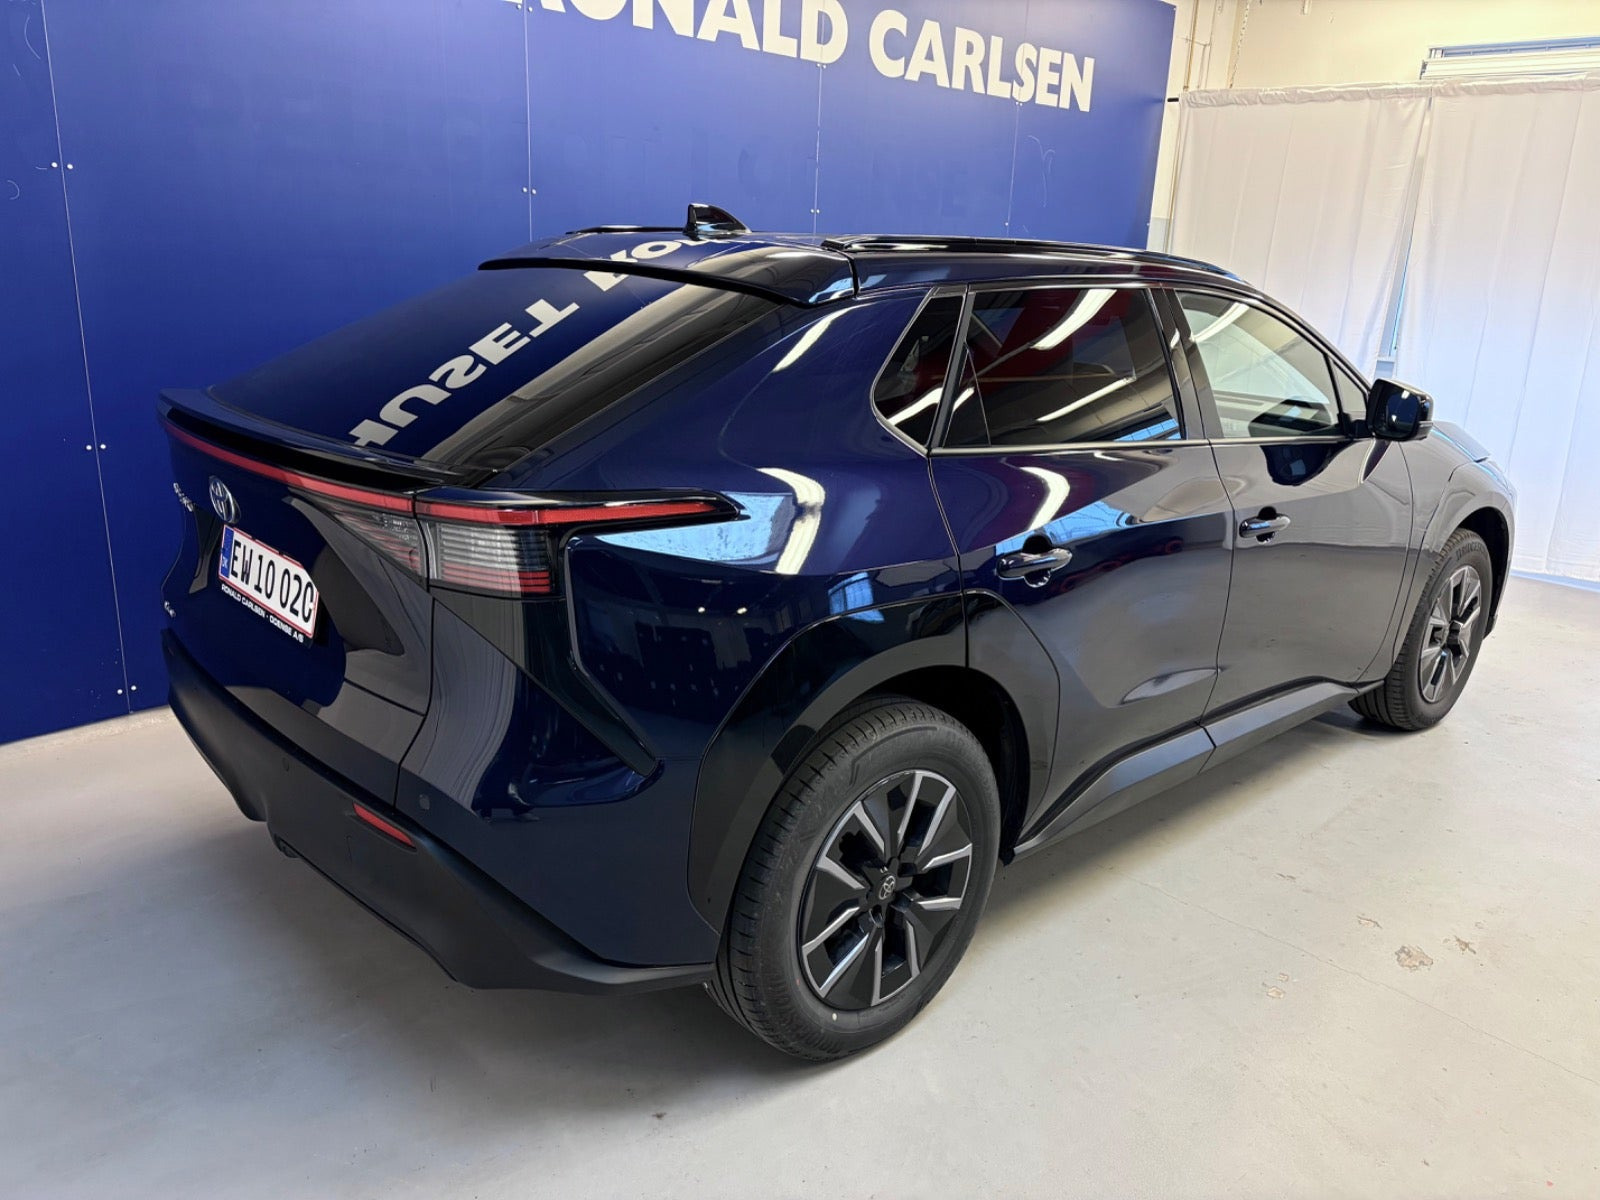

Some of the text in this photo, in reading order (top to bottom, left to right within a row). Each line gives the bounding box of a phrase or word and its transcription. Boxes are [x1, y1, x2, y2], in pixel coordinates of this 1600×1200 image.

[505, 0, 1095, 112] ALD CARLSEN
[231, 539, 253, 585] EW
[254, 554, 275, 600] 10
